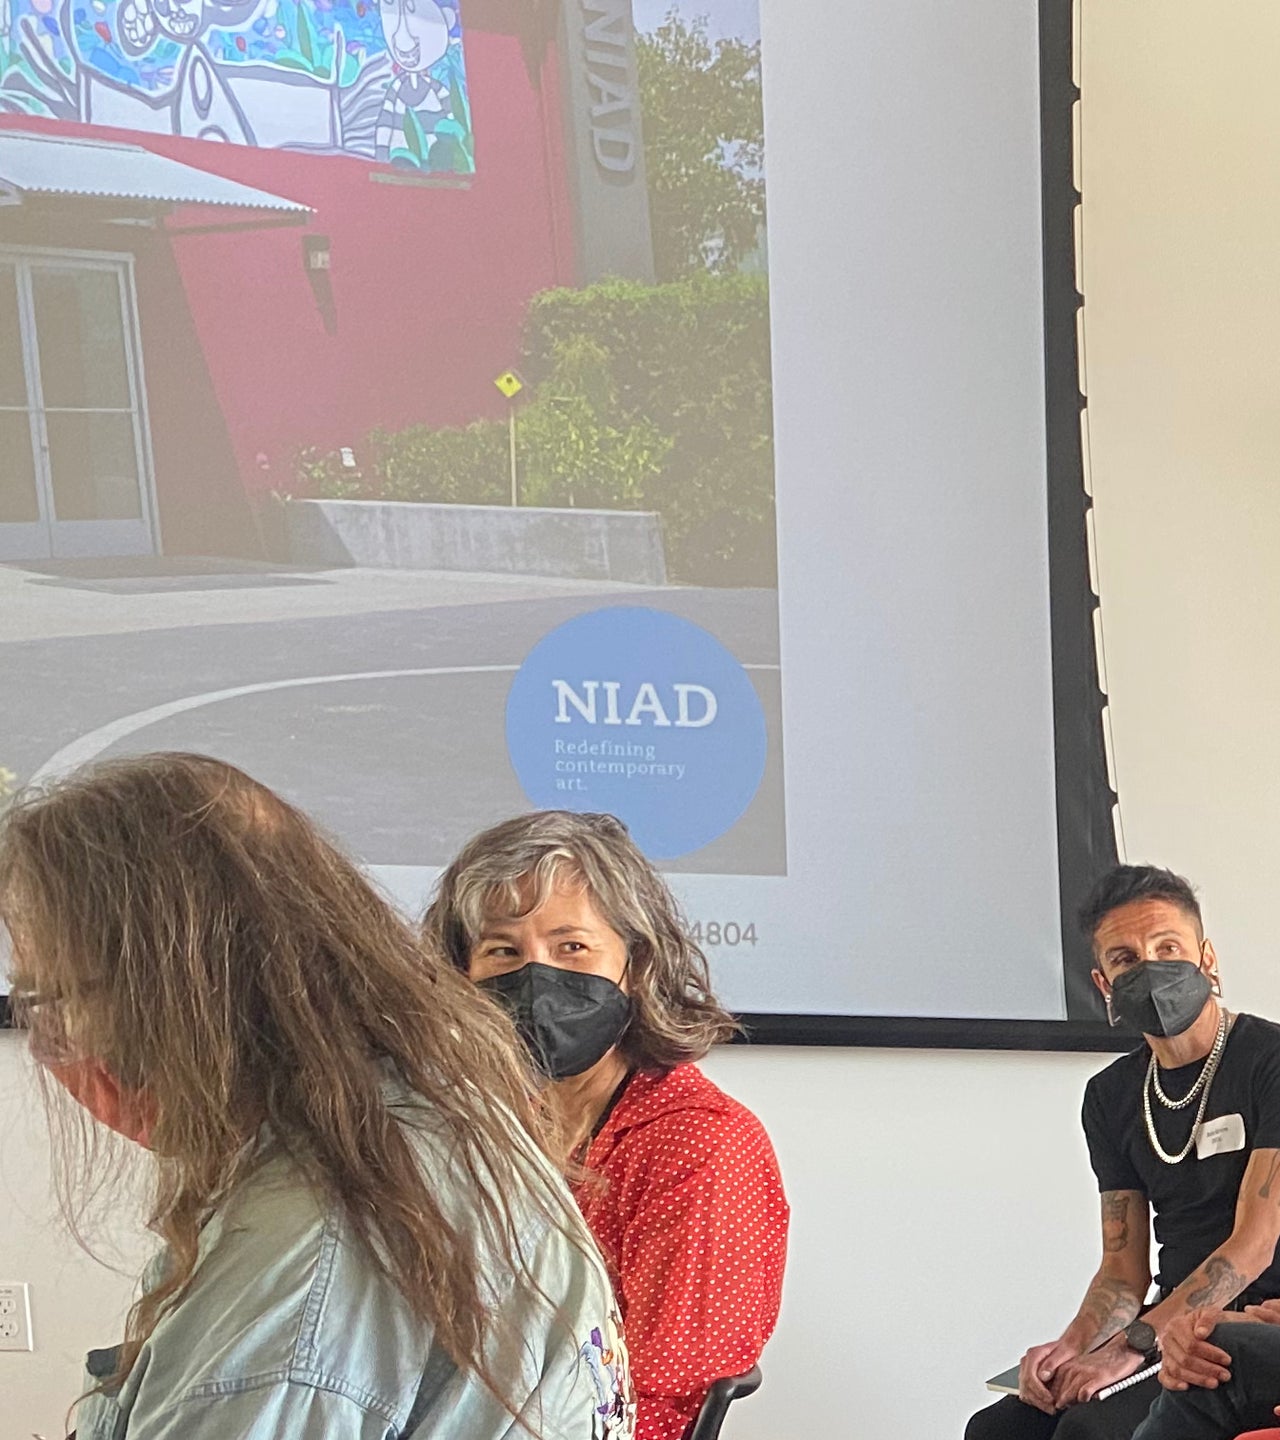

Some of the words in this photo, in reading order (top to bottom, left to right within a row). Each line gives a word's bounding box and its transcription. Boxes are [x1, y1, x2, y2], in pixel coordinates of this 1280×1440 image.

[580, 0, 635, 172] NIAD
[552, 679, 718, 728] NIAD
[554, 739, 656, 761] Redefining
[555, 759, 686, 780] contemporary
[556, 777, 588, 791] art.
[683, 920, 758, 946] 4804
